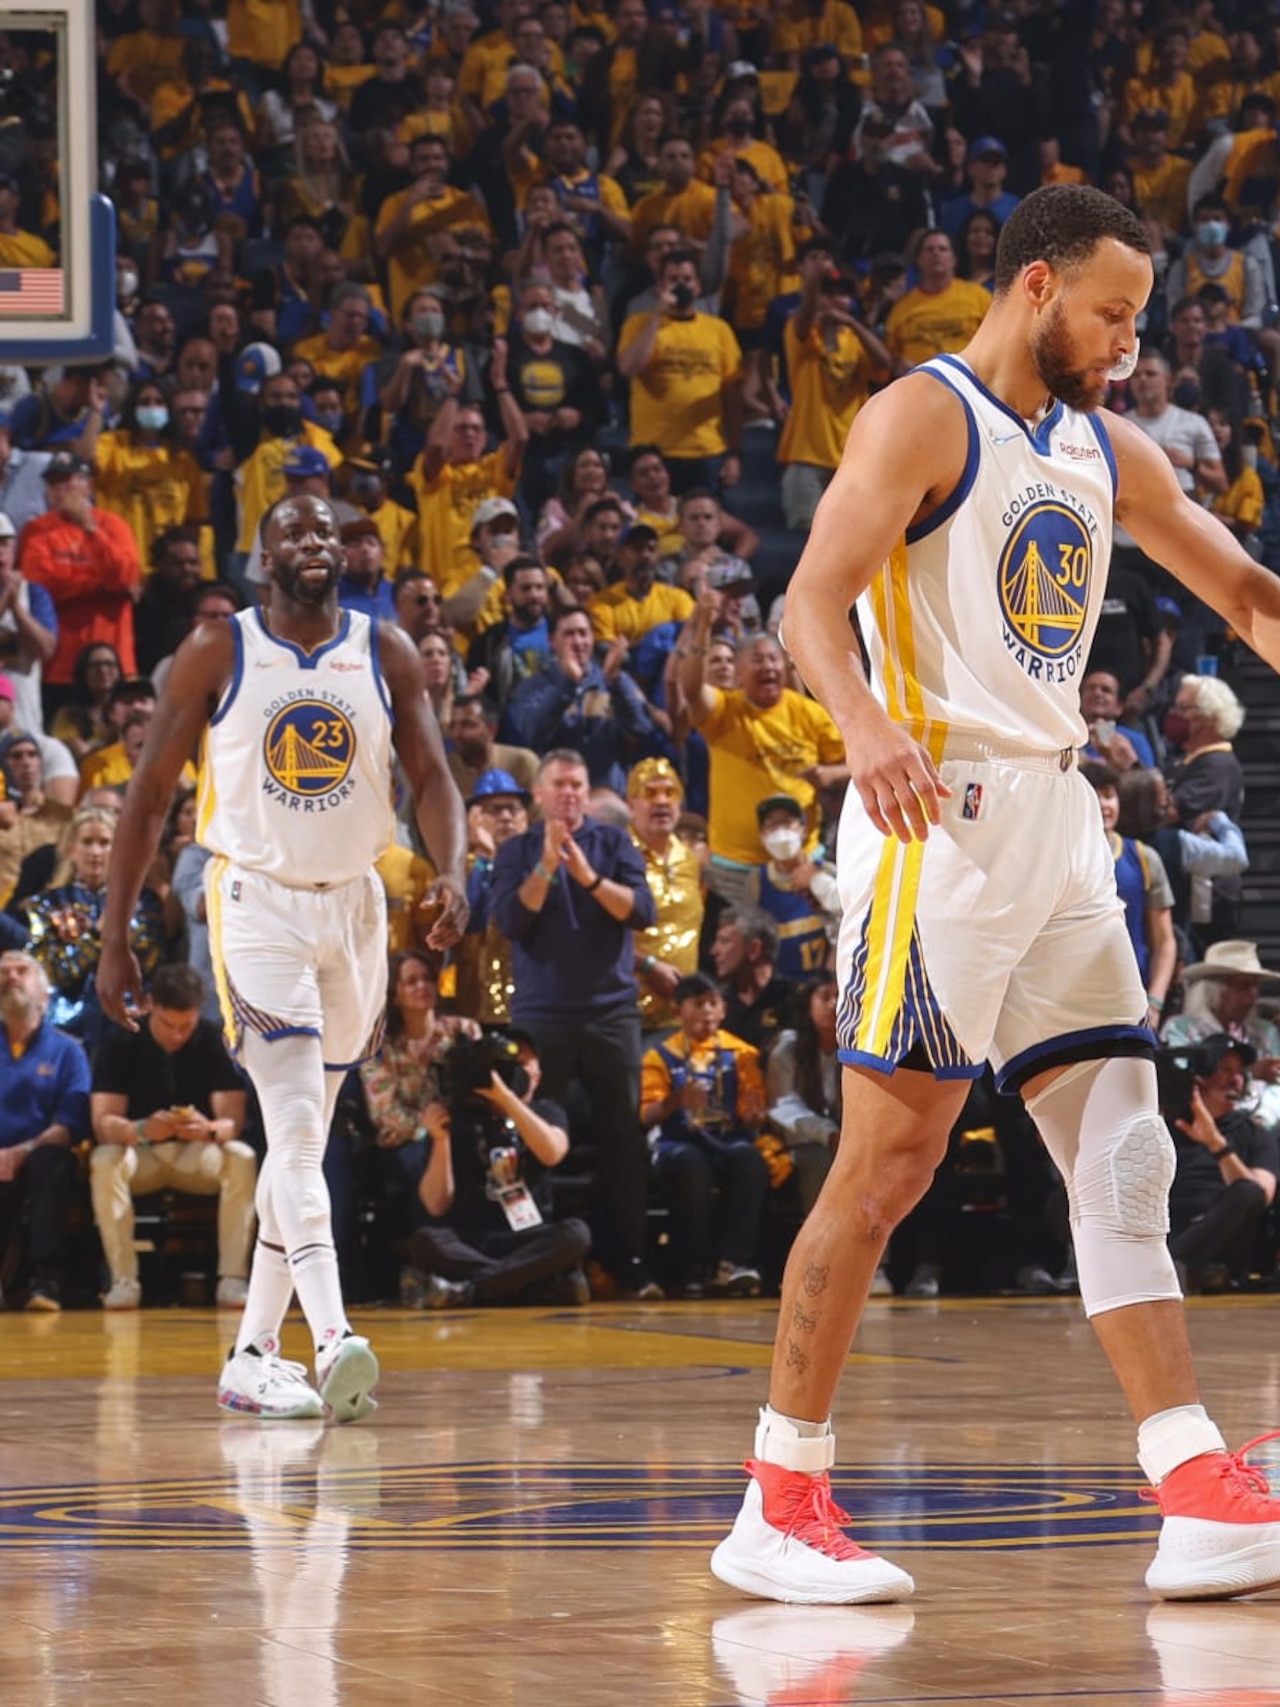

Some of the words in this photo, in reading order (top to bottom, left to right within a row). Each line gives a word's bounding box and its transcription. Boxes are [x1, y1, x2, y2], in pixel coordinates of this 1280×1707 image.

[1060, 442, 1101, 459] Rakuten
[1002, 483, 1056, 528] GOLDEN
[1061, 489, 1098, 536] STATE
[1056, 543, 1088, 588] 30
[263, 688, 315, 718] GOLDEN
[322, 691, 357, 719] STATE
[311, 720, 344, 748] 23
[262, 777, 356, 812] WARRIORS
